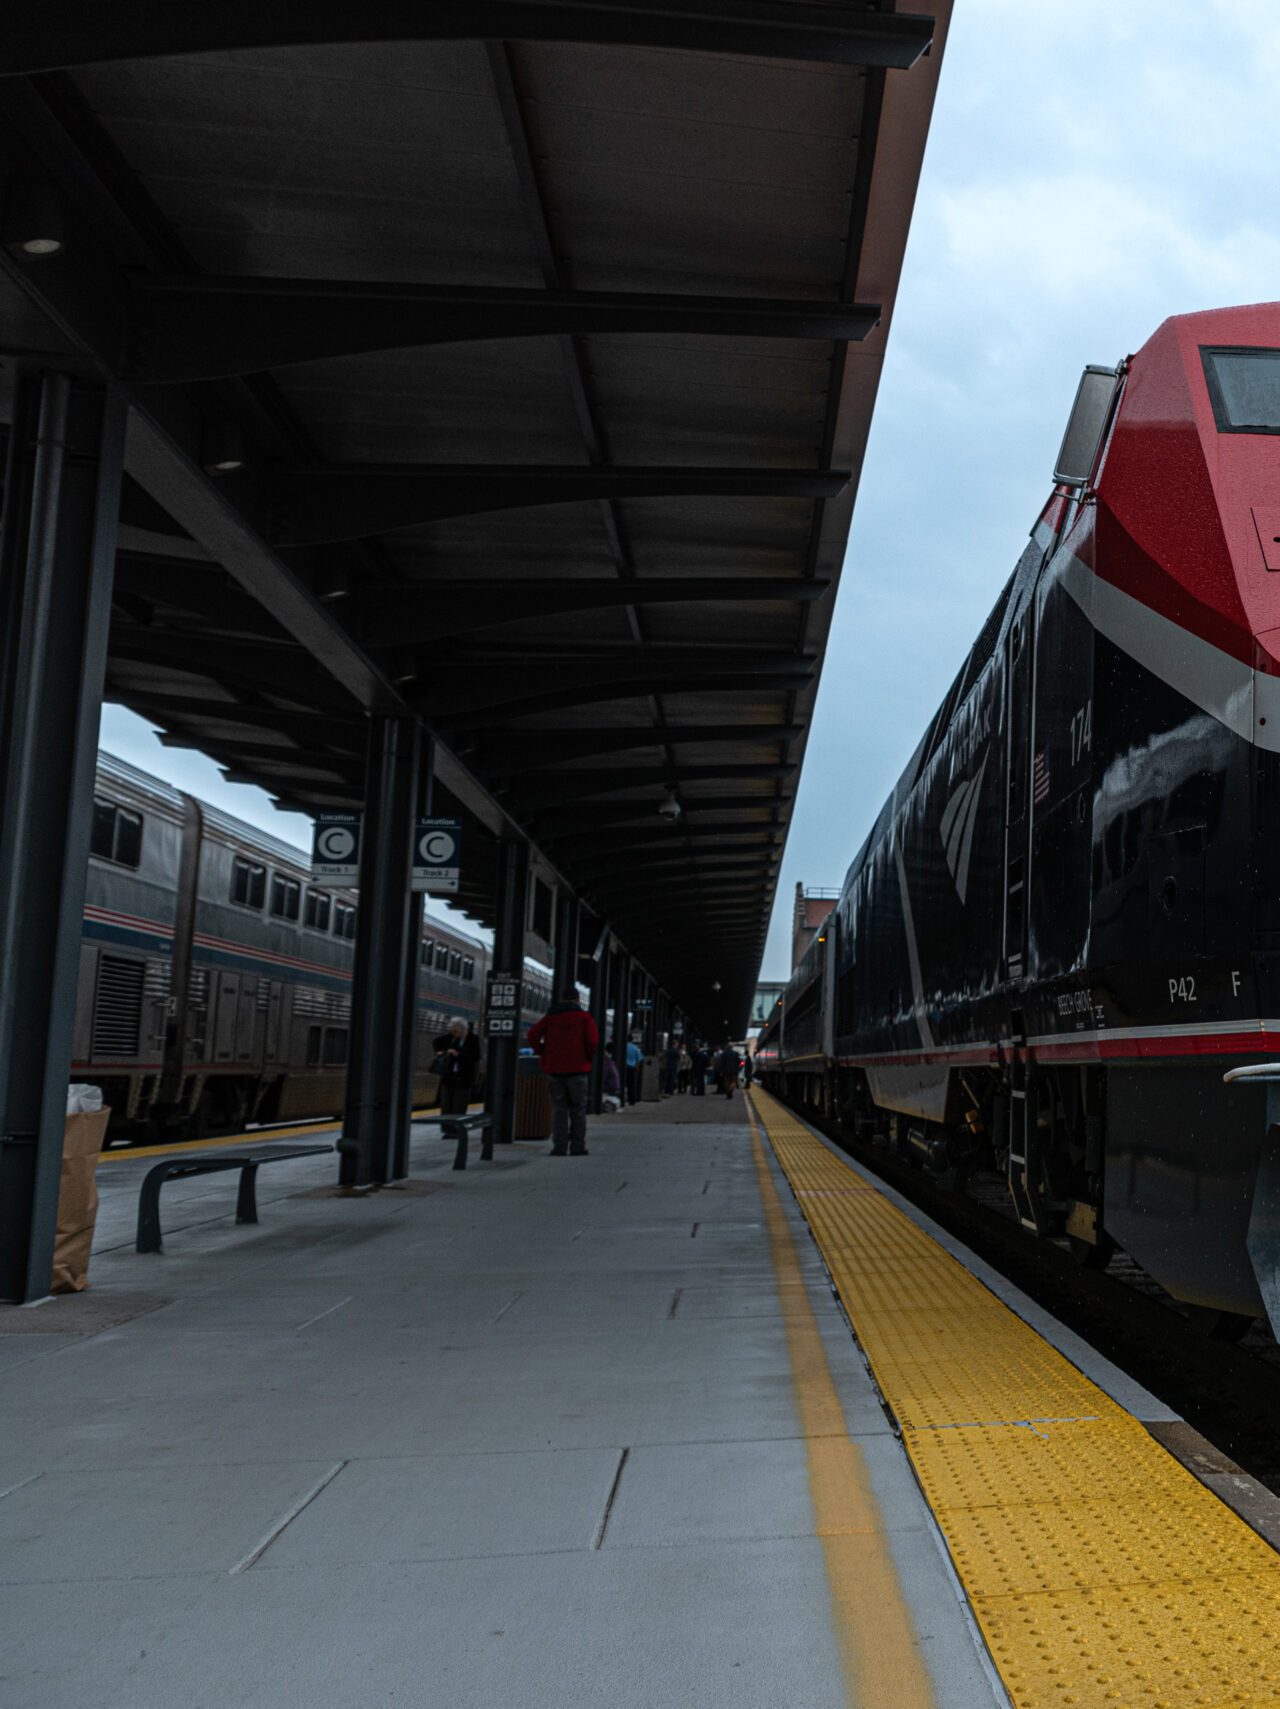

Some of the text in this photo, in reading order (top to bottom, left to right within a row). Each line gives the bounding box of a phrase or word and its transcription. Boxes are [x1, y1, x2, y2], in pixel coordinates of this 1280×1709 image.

[1070, 699, 1092, 767] 174
[320, 813, 356, 821] Location
[421, 817, 456, 825] Location
[325, 832, 344, 854] C
[426, 836, 444, 857] C
[1168, 971, 1241, 1003] P42 F
[1057, 988, 1093, 1016] BEECH GROVE
